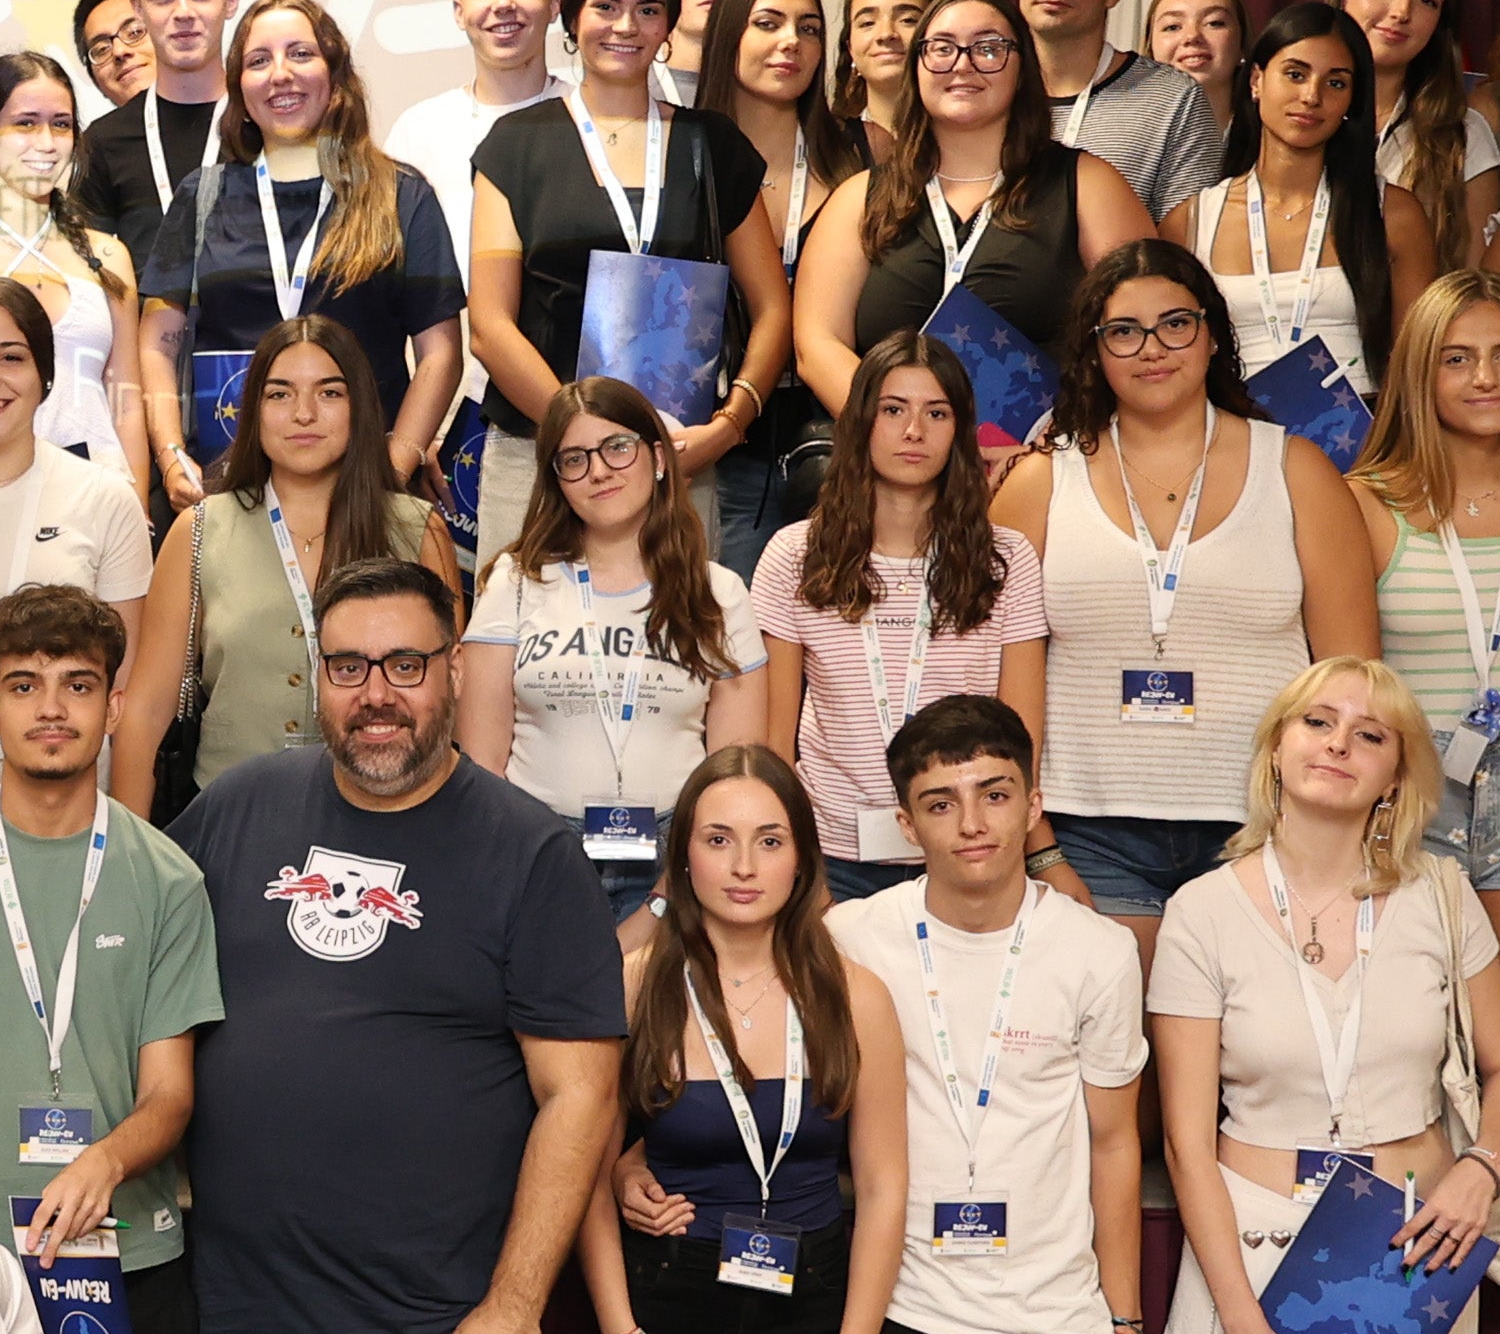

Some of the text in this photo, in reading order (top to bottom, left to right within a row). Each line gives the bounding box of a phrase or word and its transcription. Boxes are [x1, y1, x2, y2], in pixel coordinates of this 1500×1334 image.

[39, 526, 60, 536] NIKE
[316, 919, 376, 948] LEIPZIG
[39, 1277, 112, 1304] REJUV-EU
